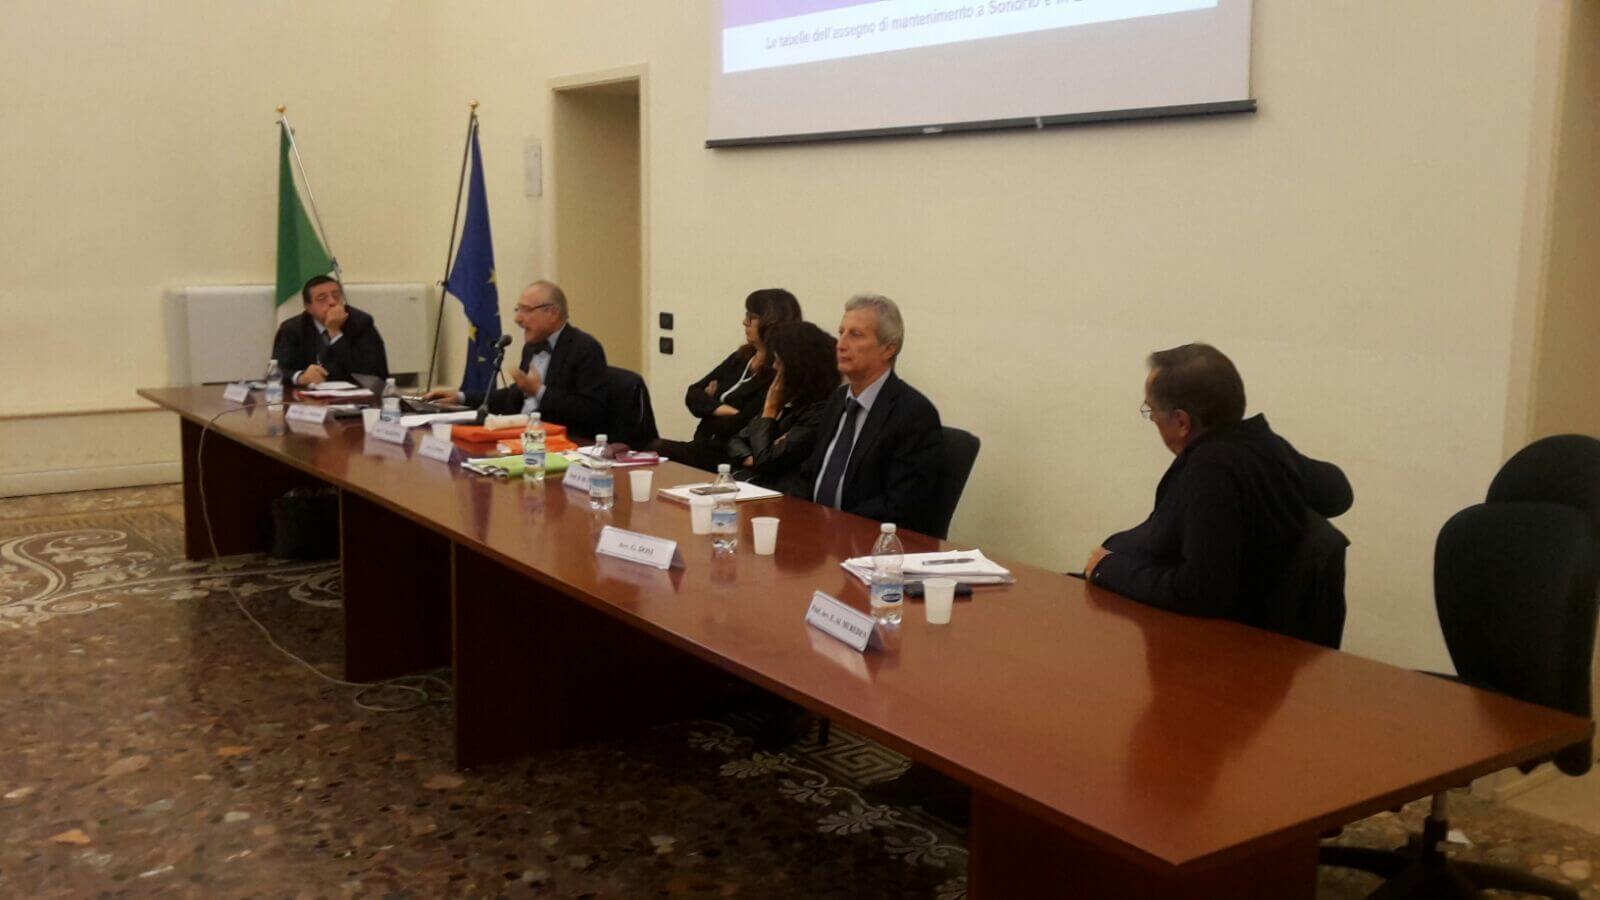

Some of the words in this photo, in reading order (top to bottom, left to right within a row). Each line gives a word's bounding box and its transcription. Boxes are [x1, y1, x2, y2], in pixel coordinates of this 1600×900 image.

[765, 36, 777, 49] Le
[779, 30, 810, 47] tabelle
[878, 16, 889, 31] di
[892, 6, 974, 30] mantenimento
[975, 5, 984, 17] a
